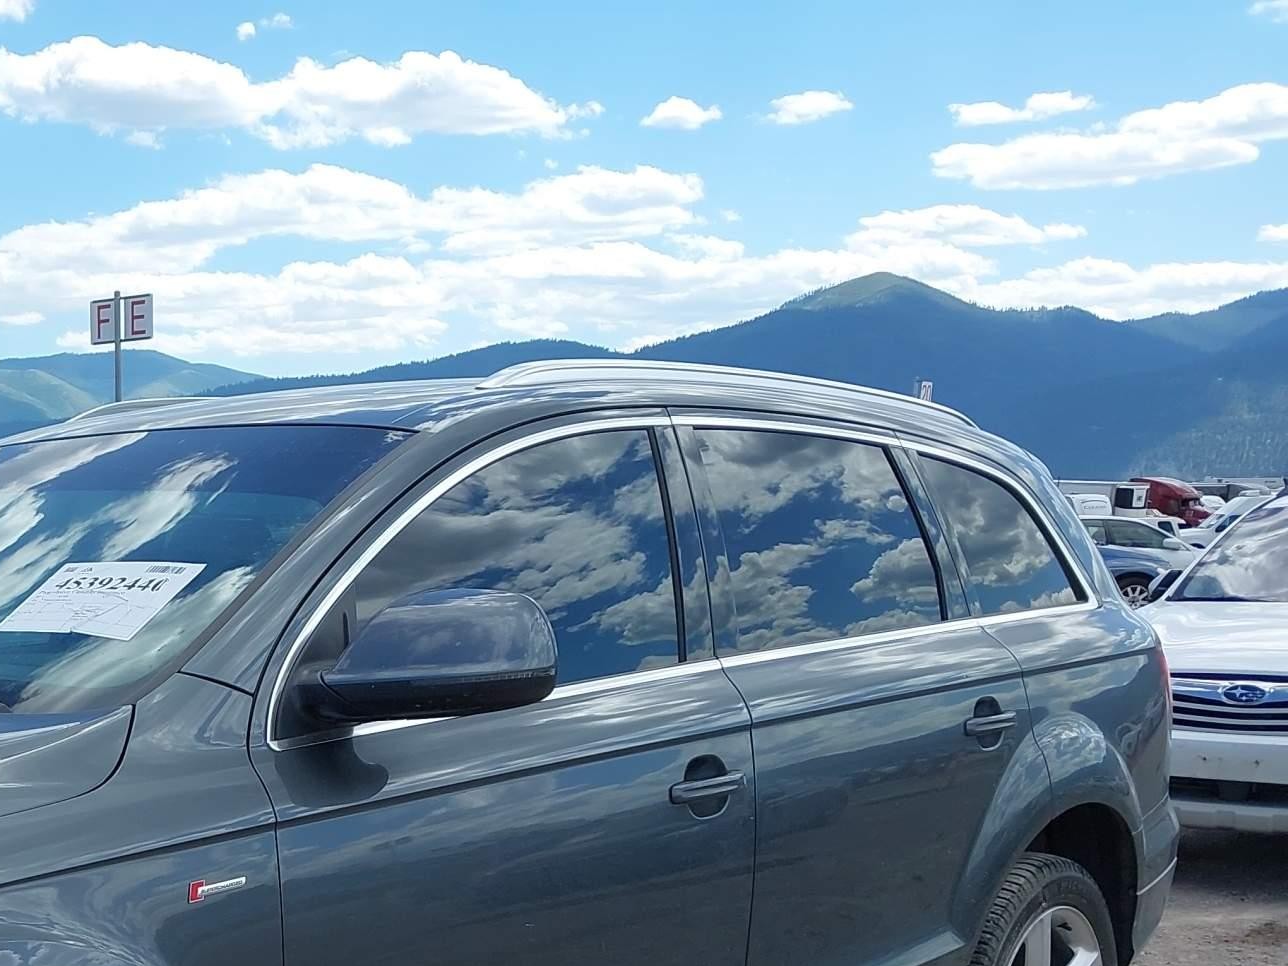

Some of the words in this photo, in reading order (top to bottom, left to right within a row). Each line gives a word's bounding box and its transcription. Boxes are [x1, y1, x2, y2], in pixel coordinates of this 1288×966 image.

[97, 304, 111, 339] F
[131, 299, 146, 336] E
[55, 576, 169, 592] 45392440
